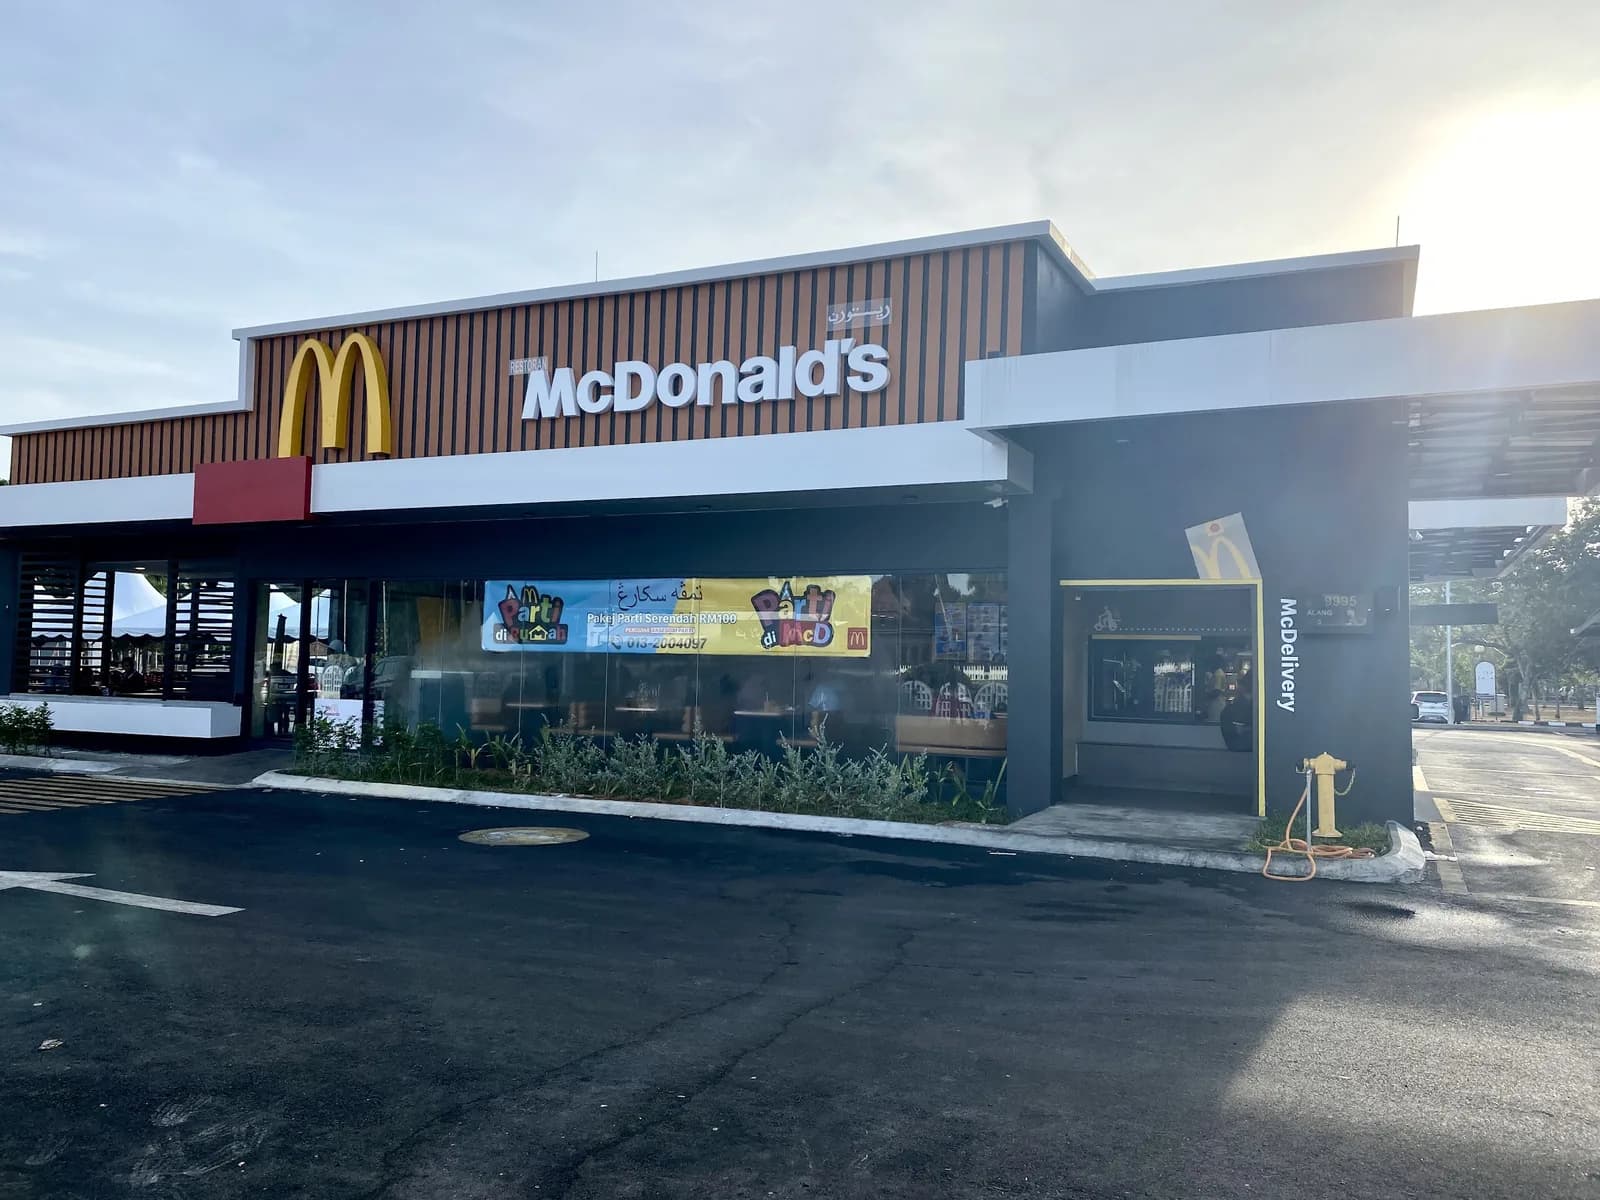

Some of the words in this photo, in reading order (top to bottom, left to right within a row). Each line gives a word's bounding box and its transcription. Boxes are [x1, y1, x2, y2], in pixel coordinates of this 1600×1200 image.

[510, 357, 548, 374] RESTORAN
[521, 338, 891, 420] McDonald's
[501, 597, 562, 627] Parti
[587, 612, 615, 626] Pakej
[618, 613, 643, 624] Parti
[645, 612, 697, 624] Serendah
[699, 613, 737, 624] RM100
[495, 628, 508, 641] di
[763, 631, 777, 646] di
[1276, 598, 1300, 713] McDelivery
